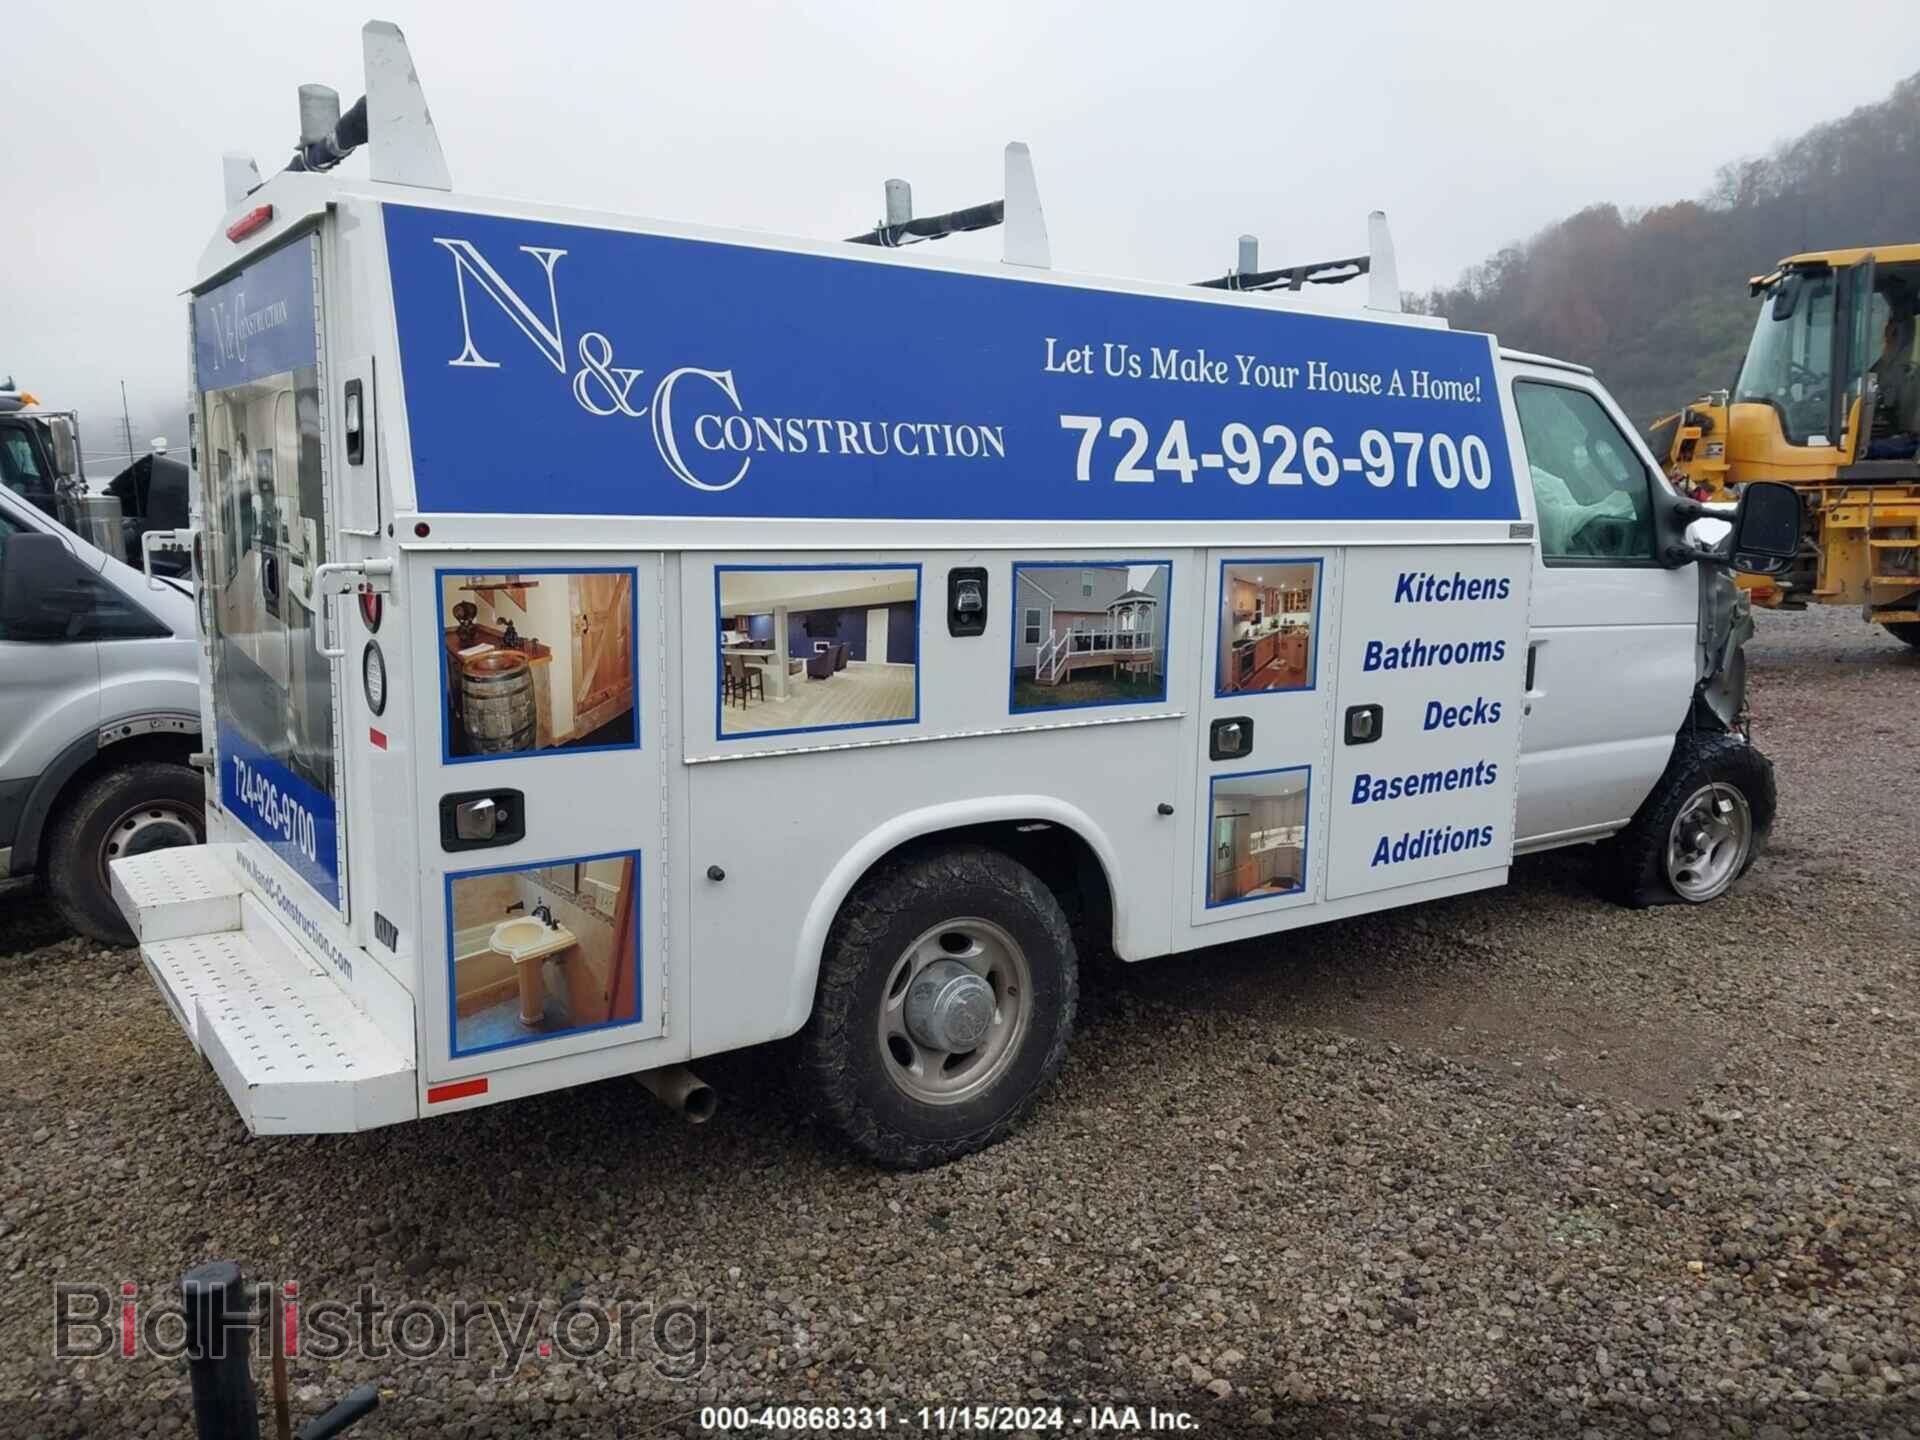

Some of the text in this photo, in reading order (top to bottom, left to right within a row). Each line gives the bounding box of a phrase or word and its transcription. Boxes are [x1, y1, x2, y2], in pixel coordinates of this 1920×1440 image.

[1044, 337, 1482, 403] Let Us Make Your House A Home!
[1060, 414, 1492, 490] 724-926-9700
[1394, 572, 1510, 603] Kitchens
[1363, 638, 1506, 672] Bathrooms
[1424, 697, 1502, 731] Decks
[1351, 760, 1497, 805] Basements
[233, 755, 316, 862] 724-926-9700
[1371, 825, 1494, 867] Additions
